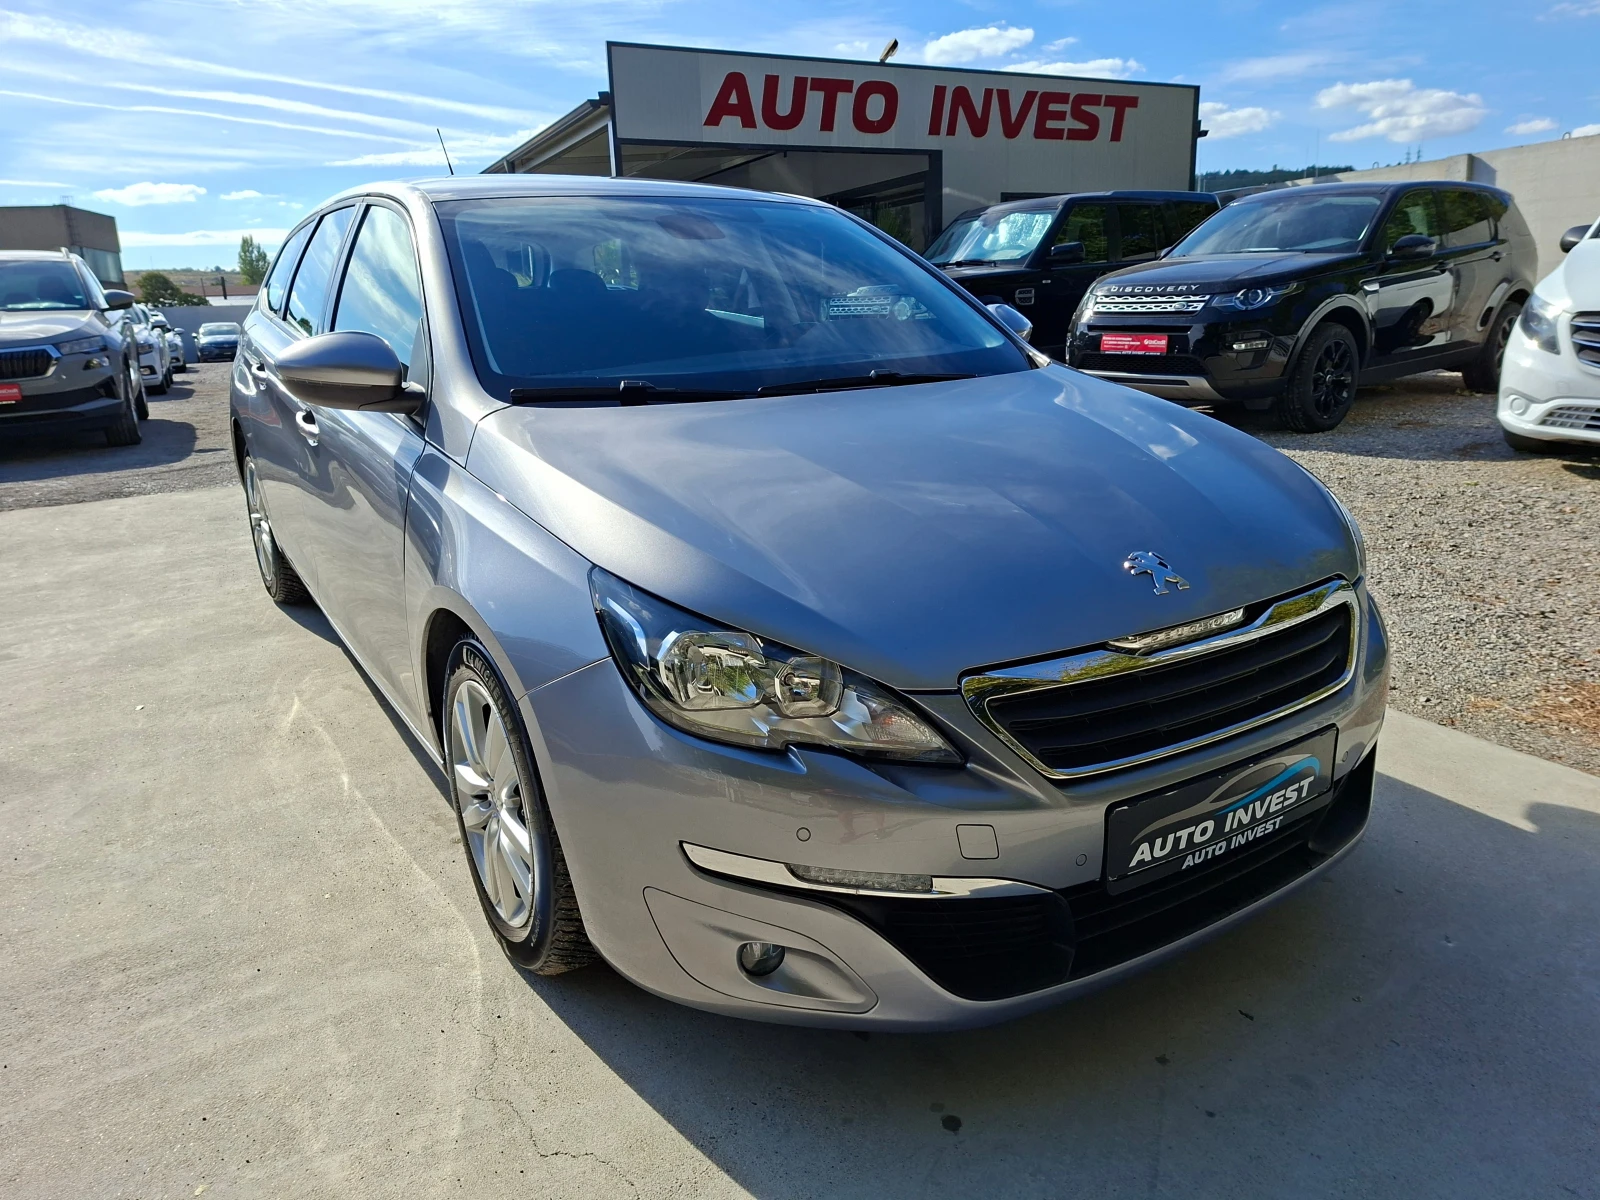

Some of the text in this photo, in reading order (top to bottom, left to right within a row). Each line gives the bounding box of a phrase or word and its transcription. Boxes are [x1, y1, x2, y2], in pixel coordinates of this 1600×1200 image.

[703, 71, 1139, 142] AUTO INVEST
[1110, 285, 1200, 293] DISCOVERY
[474, 656, 514, 730] MICHELIN
[1128, 776, 1315, 868] AUTO INVEST
[1181, 816, 1284, 870] AUTO INVEST
